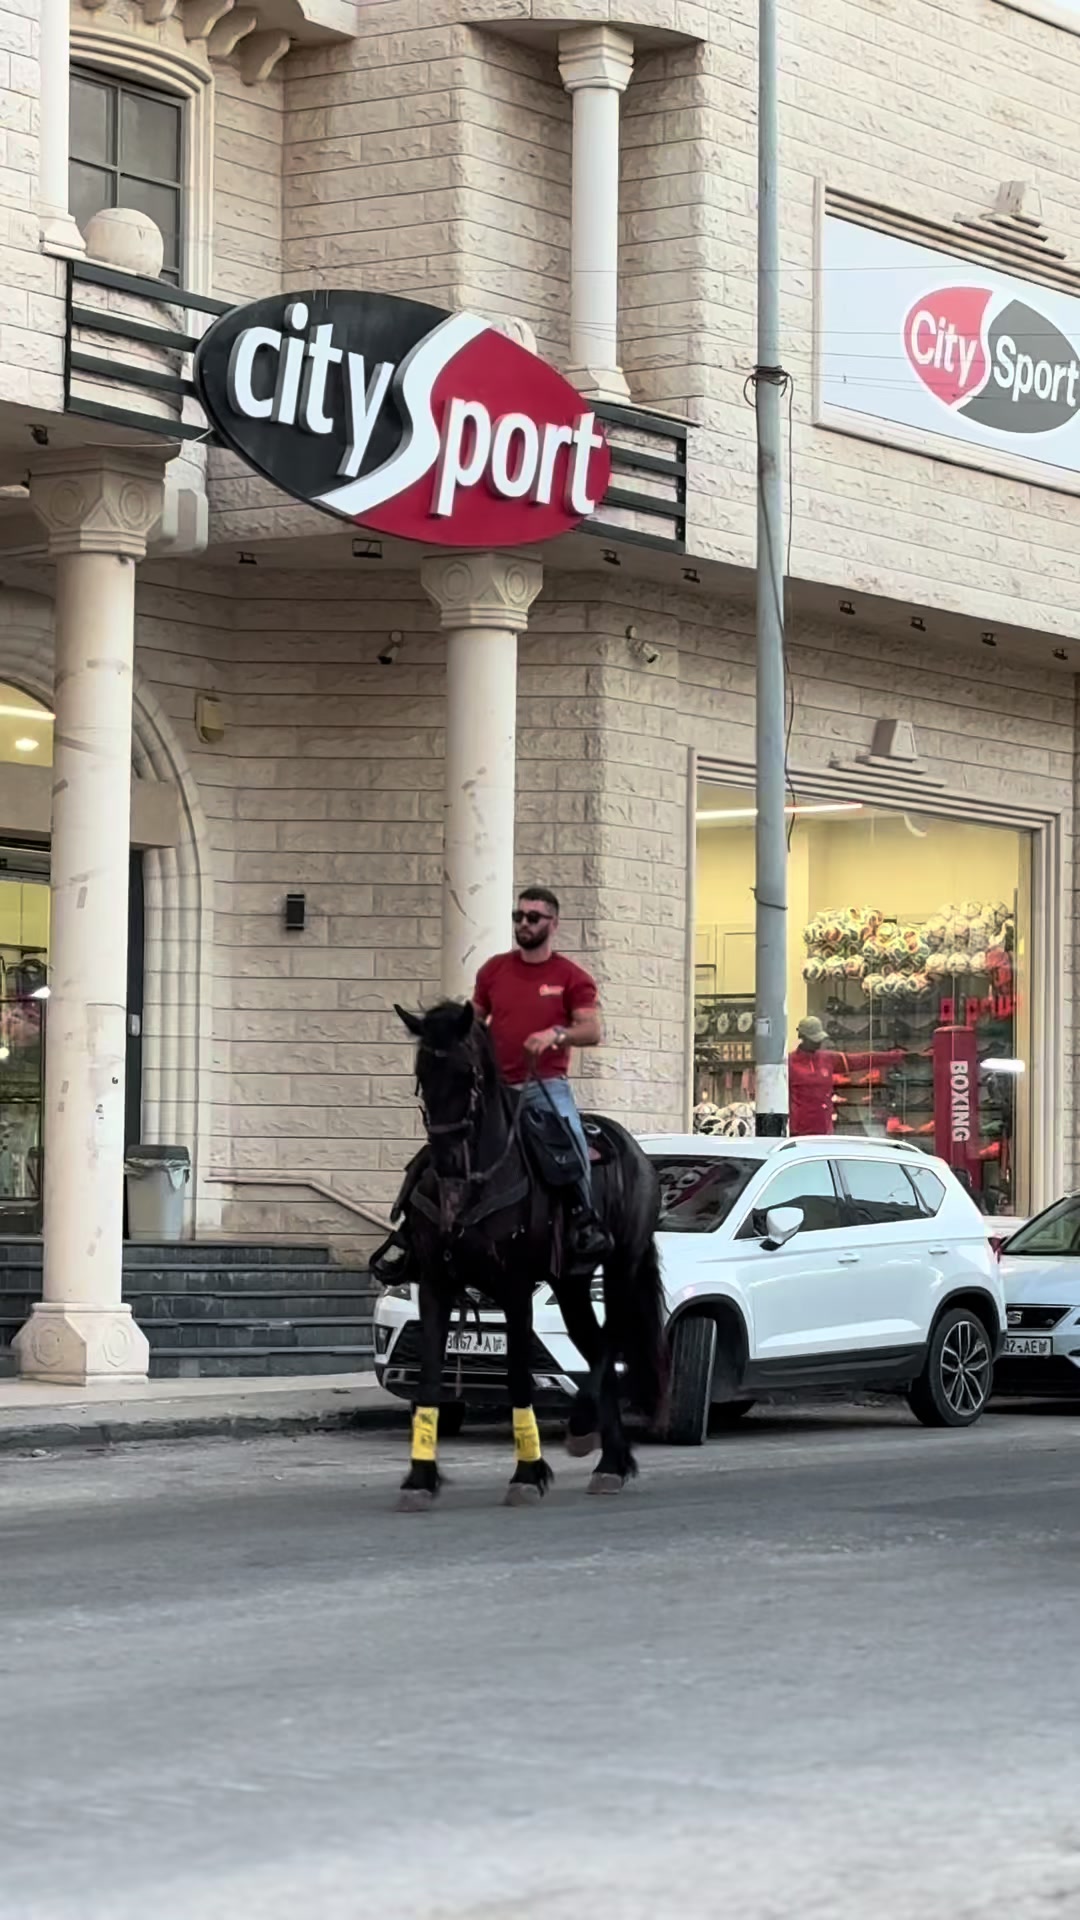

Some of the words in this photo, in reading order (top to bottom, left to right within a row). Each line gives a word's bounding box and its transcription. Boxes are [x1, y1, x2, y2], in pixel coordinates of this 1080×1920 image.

[229, 302, 395, 478] city
[310, 310, 602, 518] Sport
[911, 309, 978, 388] City
[993, 334, 1080, 408] Sport
[950, 1060, 971, 1142] BOXING
